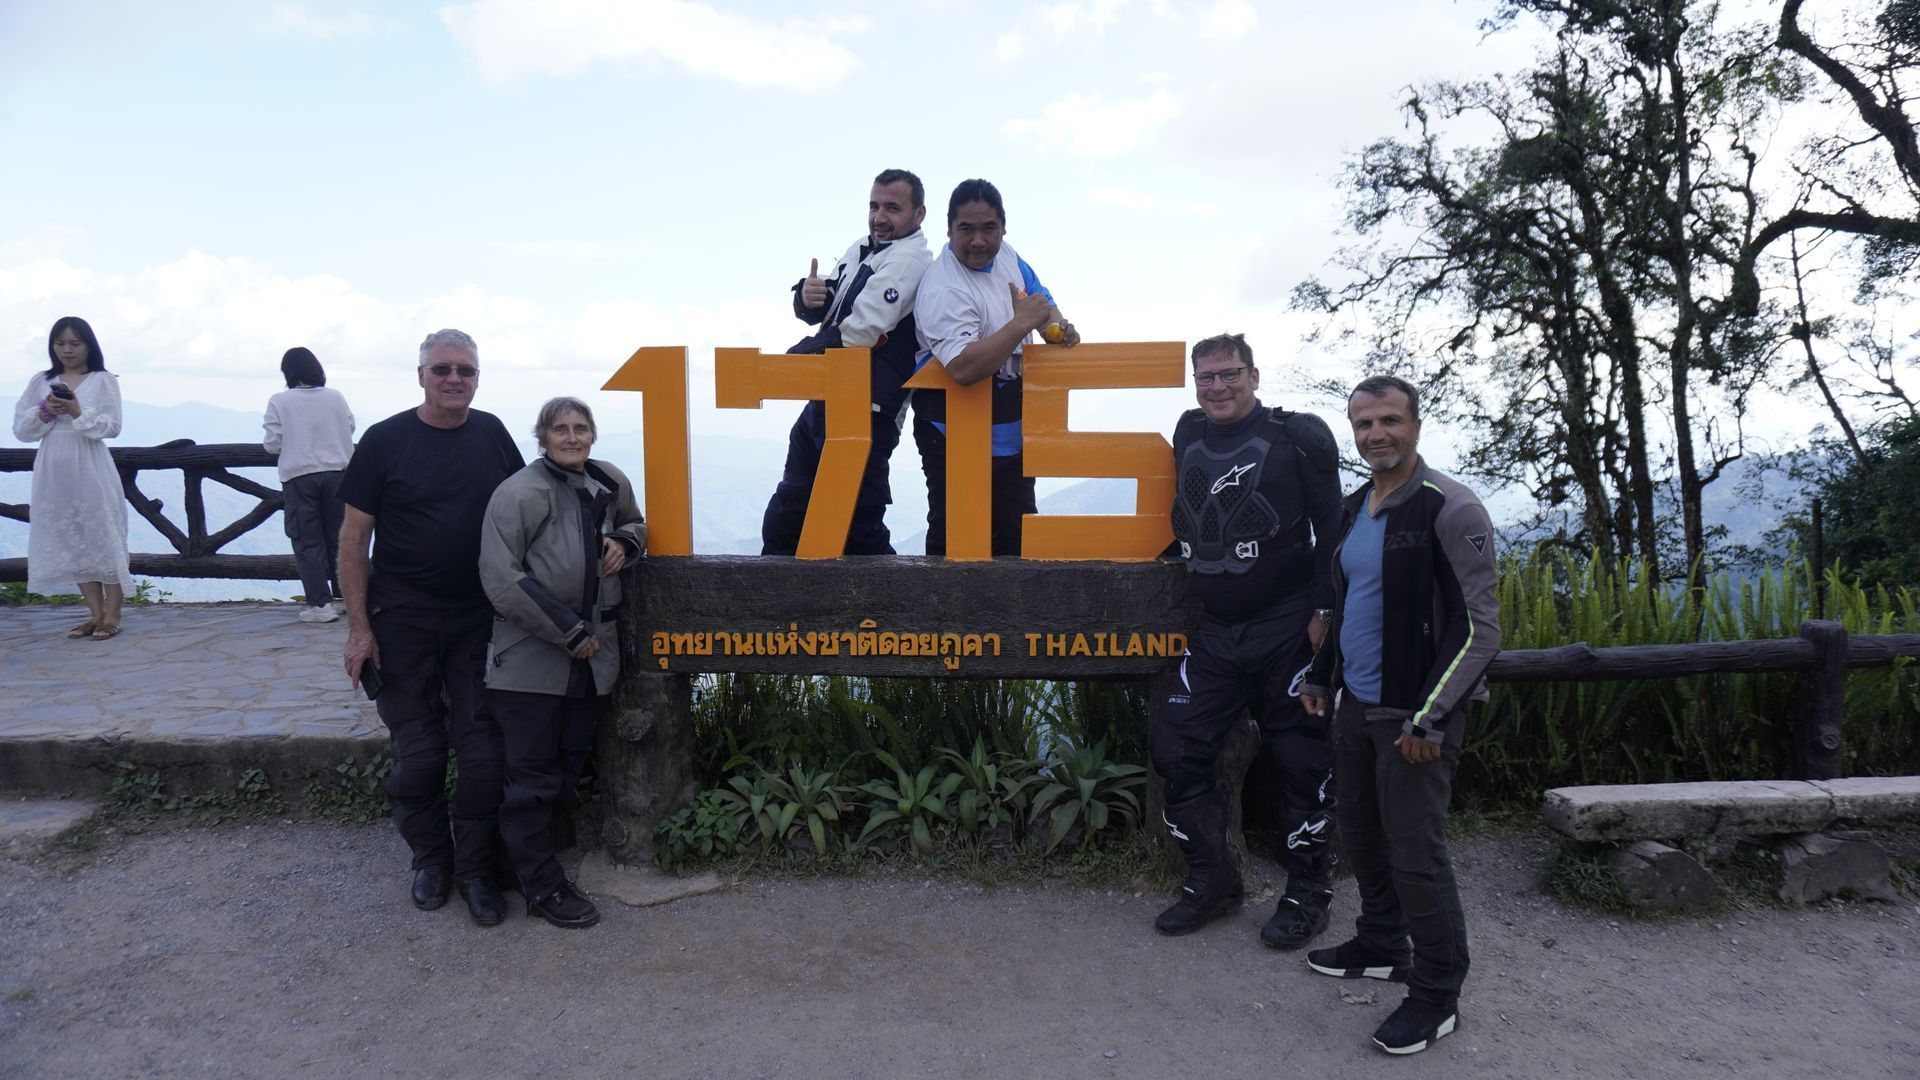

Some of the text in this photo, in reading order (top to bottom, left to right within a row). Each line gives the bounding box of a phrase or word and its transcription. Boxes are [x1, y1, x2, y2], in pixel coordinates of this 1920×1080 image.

[600, 341, 1186, 561] 1715
[652, 619, 1000, 670] อุทยานแห่งชาติดอยภูคา
[1025, 632, 1188, 657] THAILAND
